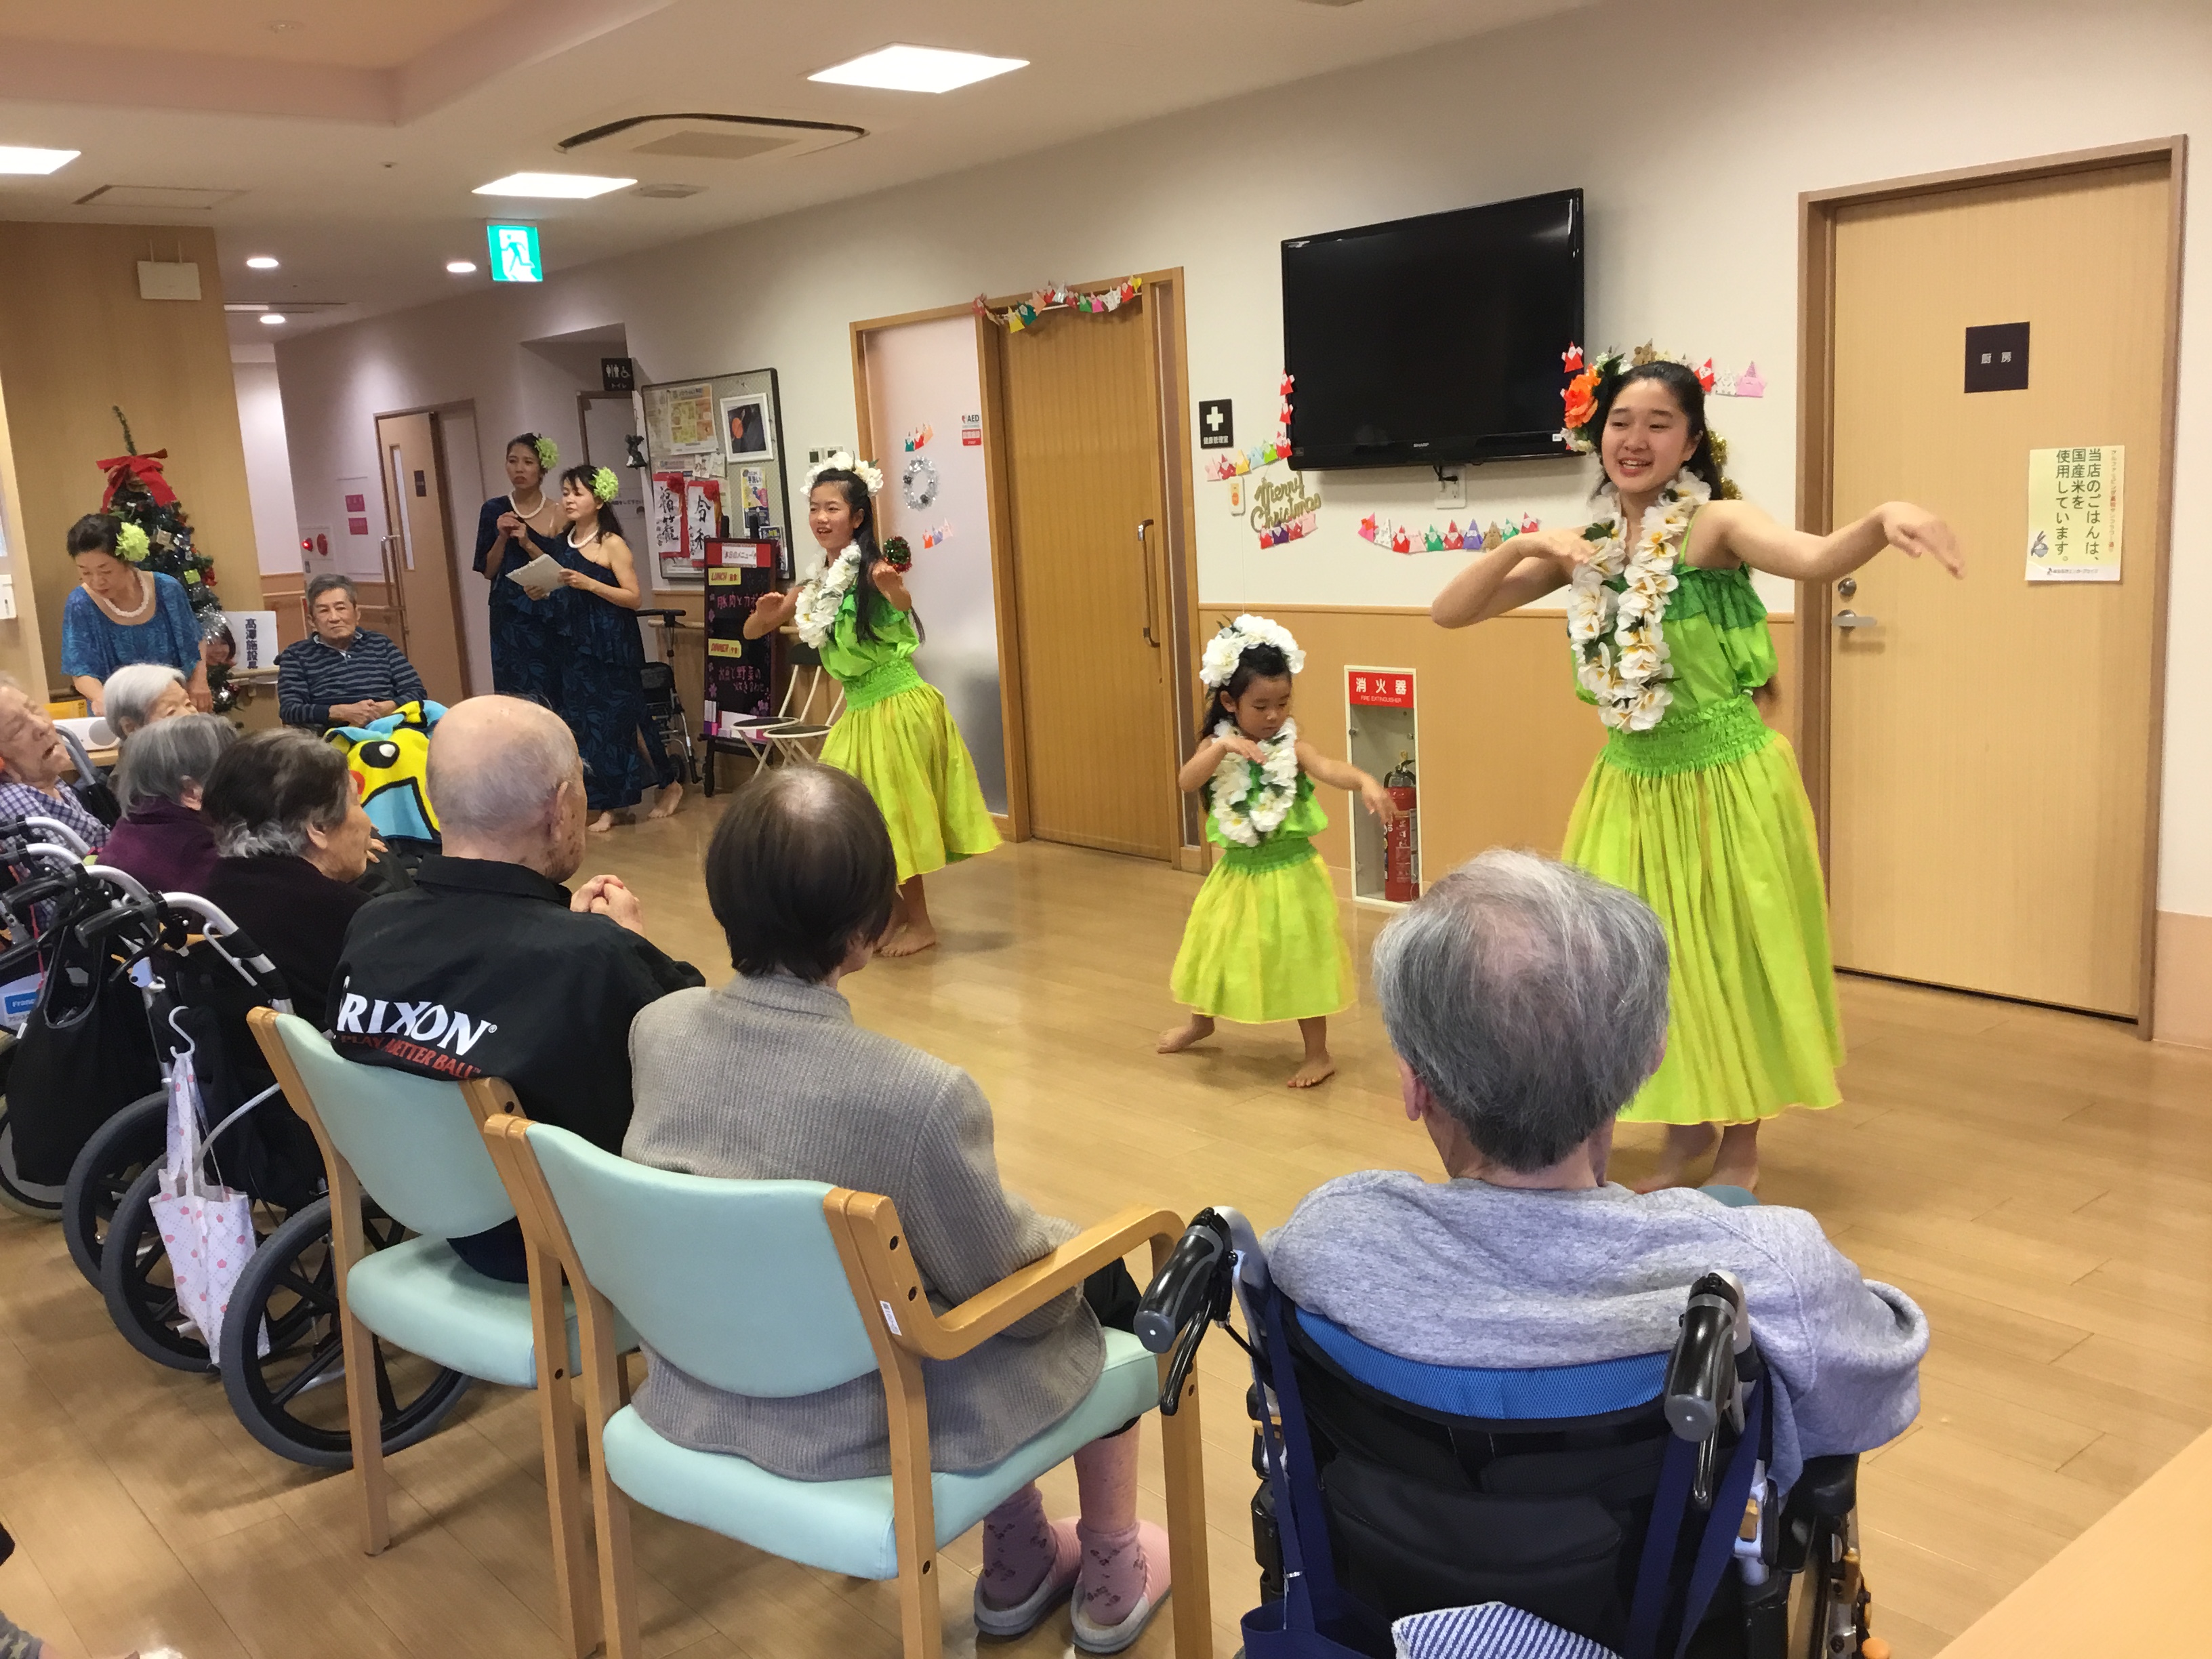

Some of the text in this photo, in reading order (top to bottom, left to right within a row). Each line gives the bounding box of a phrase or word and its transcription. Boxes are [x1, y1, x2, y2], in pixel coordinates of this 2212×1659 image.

[1980, 351, 2012, 365] 厨房
[967, 414, 980, 422] AED
[1250, 470, 1322, 533] Merry Christmas
[2055, 449, 2070, 562] 使用しています。
[2071, 448, 2087, 510] 国産米を
[2085, 448, 2102, 560] 当店のごはんは、
[711, 572, 727, 581] LUNCH
[1355, 676, 1407, 695] 消火器
[336, 992, 493, 1057] RIXON
